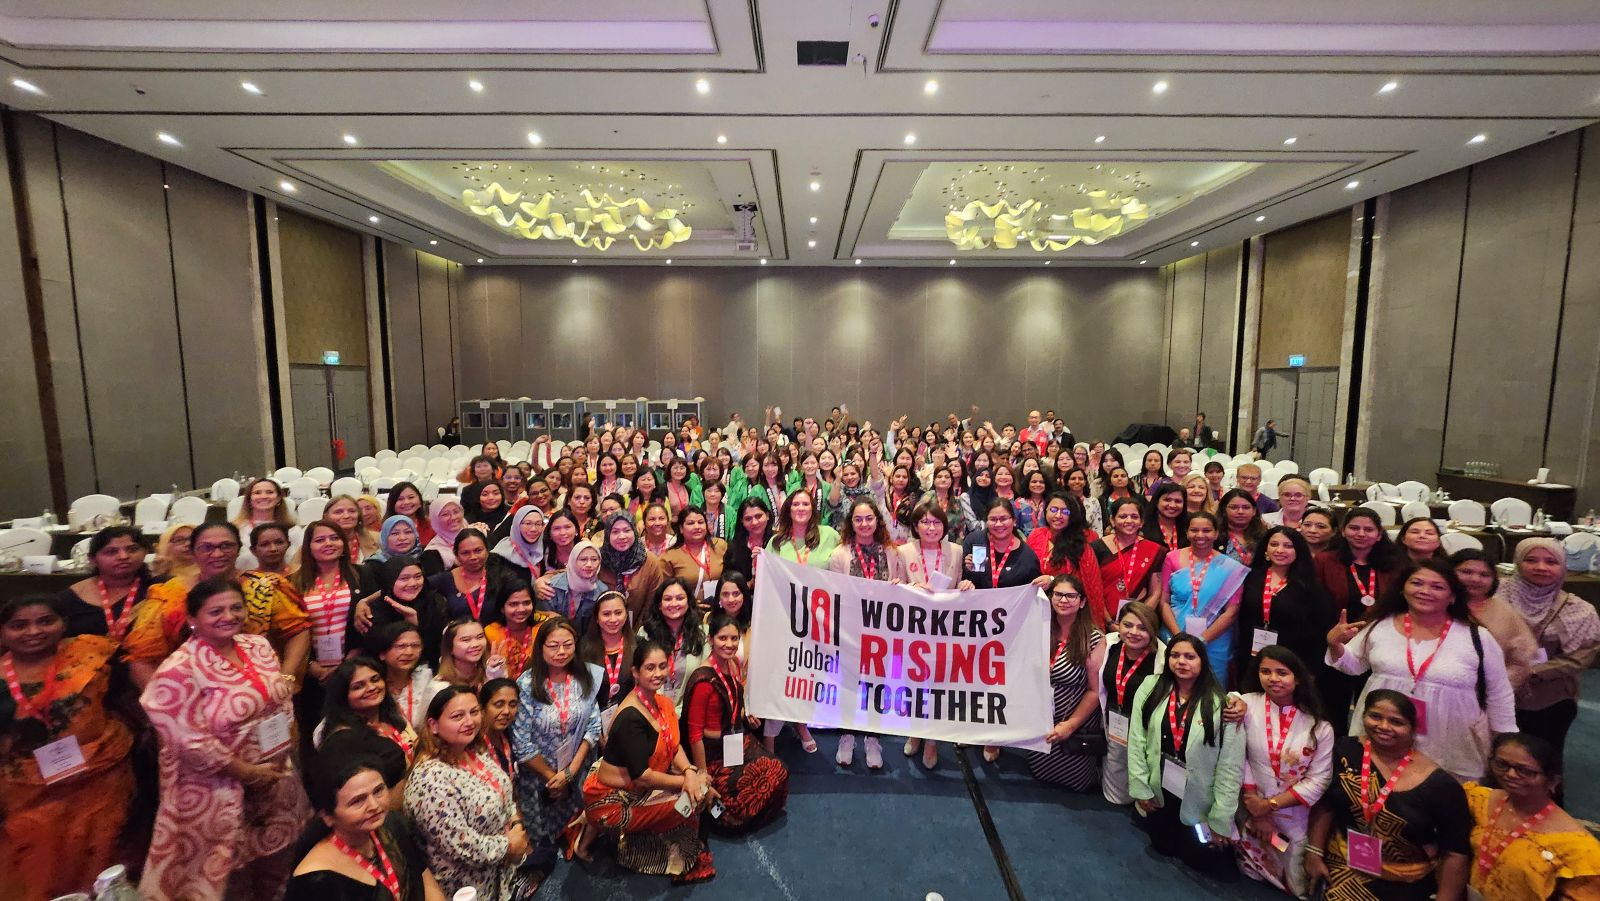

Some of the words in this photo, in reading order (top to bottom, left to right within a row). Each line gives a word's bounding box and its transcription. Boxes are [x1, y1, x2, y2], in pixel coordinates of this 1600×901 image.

[861, 598, 1008, 638] WORKERS
[788, 641, 840, 674] global
[860, 634, 1006, 686] RISING
[784, 673, 838, 706] union
[858, 680, 1007, 725] TOGETHER
